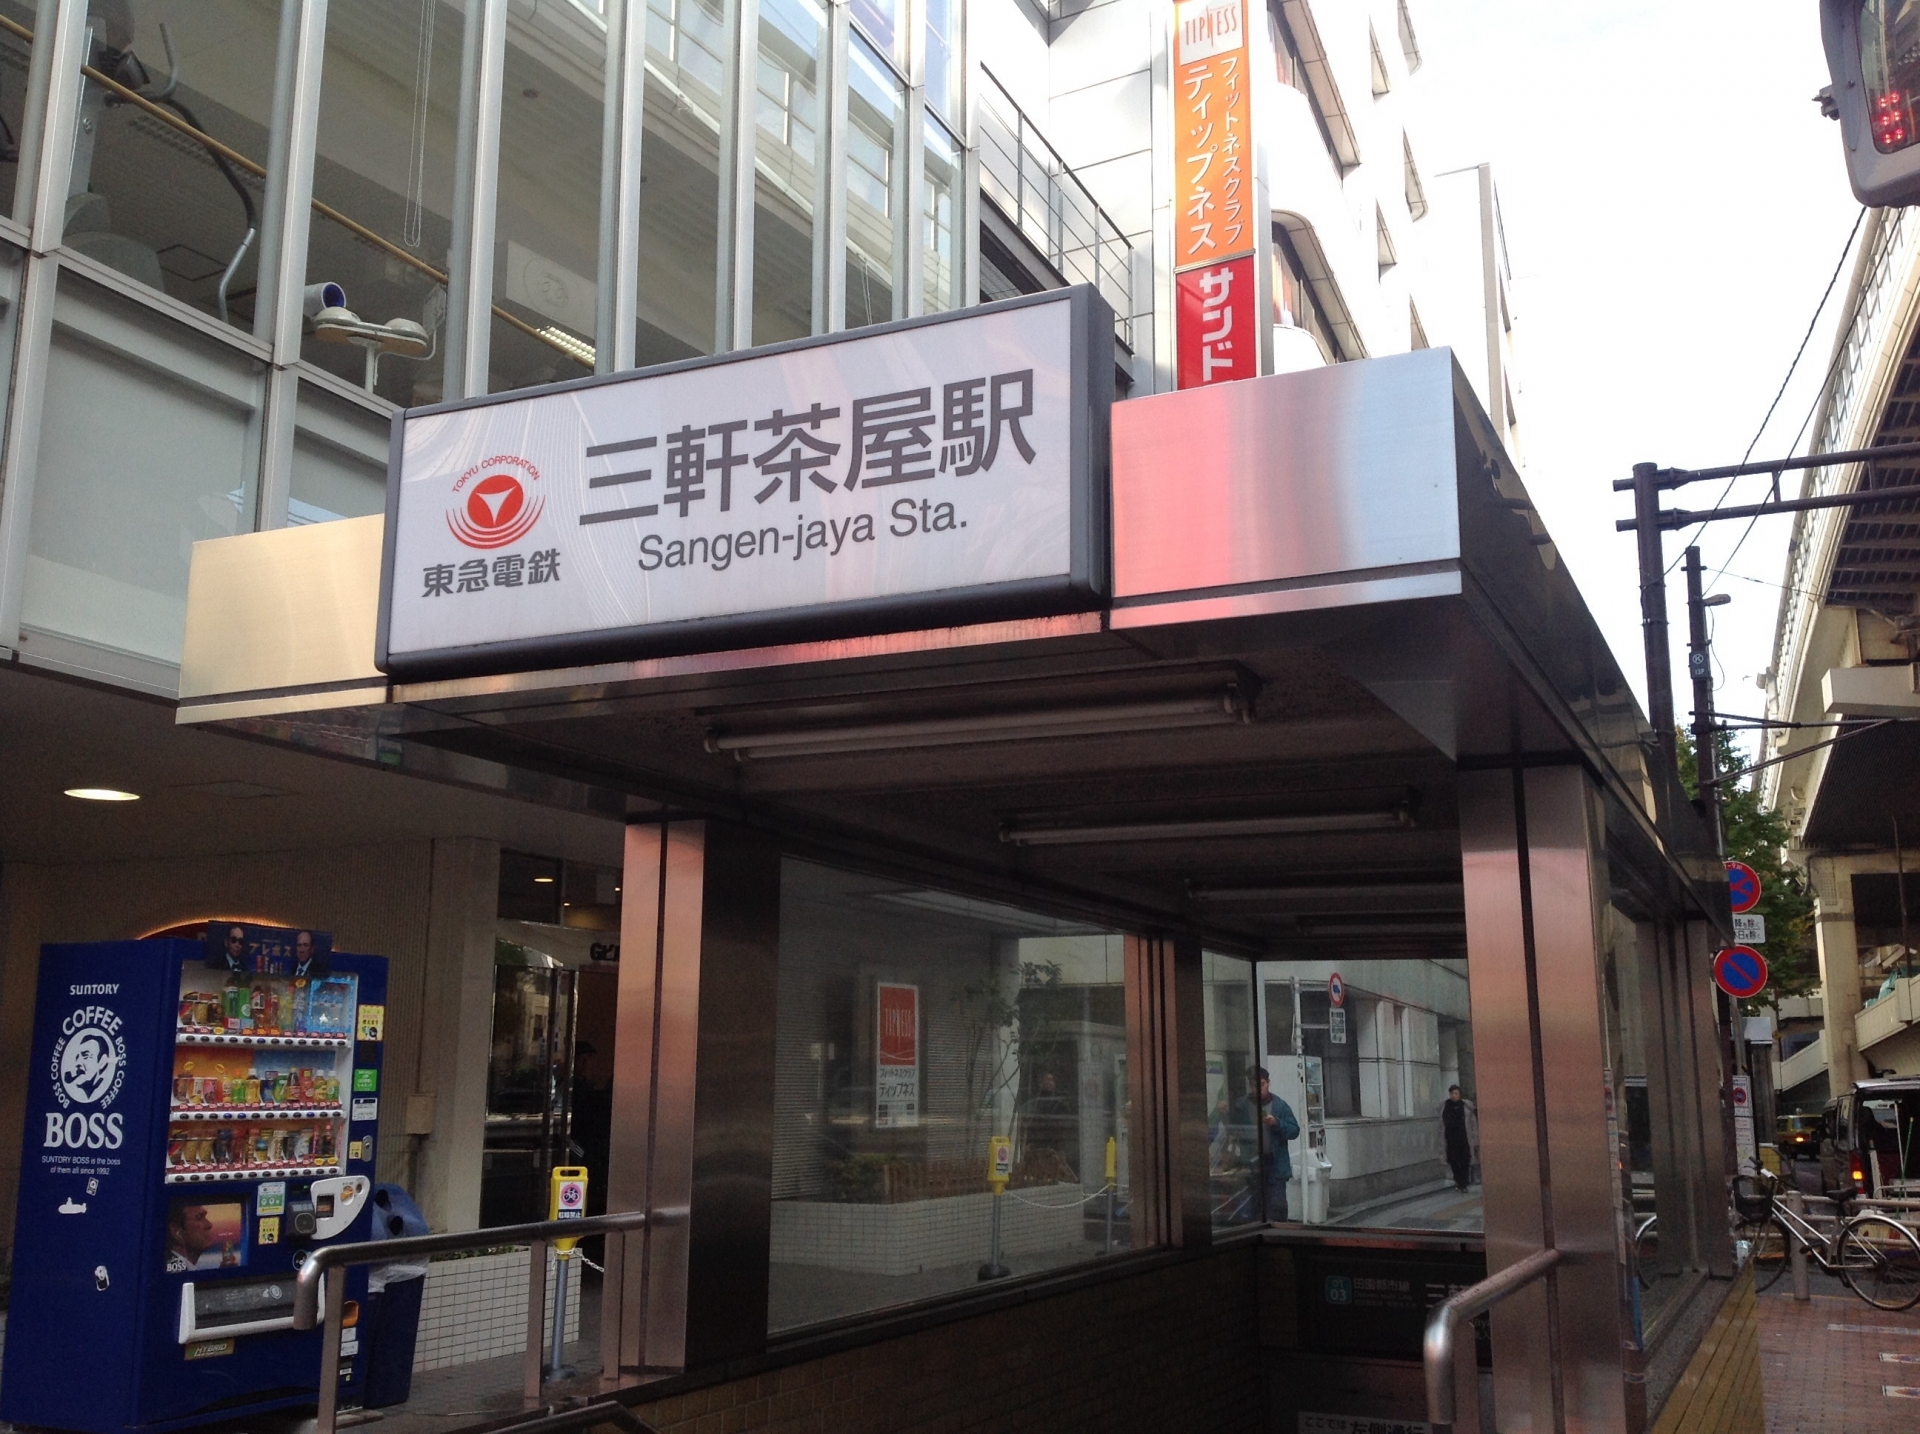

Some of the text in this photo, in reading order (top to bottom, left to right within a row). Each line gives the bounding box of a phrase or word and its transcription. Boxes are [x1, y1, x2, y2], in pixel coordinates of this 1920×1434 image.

[1184, 4, 1238, 48] TIPNESS
[1183, 65, 1218, 256] ティップネス
[1220, 56, 1246, 245] フィットネスクラブ
[1199, 266, 1234, 383] サンド
[578, 368, 1037, 526] 三軒茶屋駅
[451, 454, 541, 494] TOKYU CORPORATION
[637, 498, 968, 573] Sangen-jaya Sta.
[422, 547, 562, 598] 東急電鉄
[62, 1005, 123, 1037] COFFEE
[50, 1036, 71, 1109] BOSS COFFEE
[100, 1036, 127, 1110] BOSS COFFEE
[879, 1082, 916, 1098] ティップネス
[43, 1111, 124, 1150] BOSS
[41, 1155, 72, 1164] SUNTORY
[72, 1156, 90, 1164] BOSS
[106, 1158, 121, 1166] boss
[57, 1166, 71, 1174] them
[79, 1167, 95, 1175] since
[166, 1262, 187, 1272] BOSS
[1353, 1277, 1410, 1292] 田園都市線
[1330, 1289, 1347, 1301] 03
[195, 1344, 227, 1355] HYBRID
